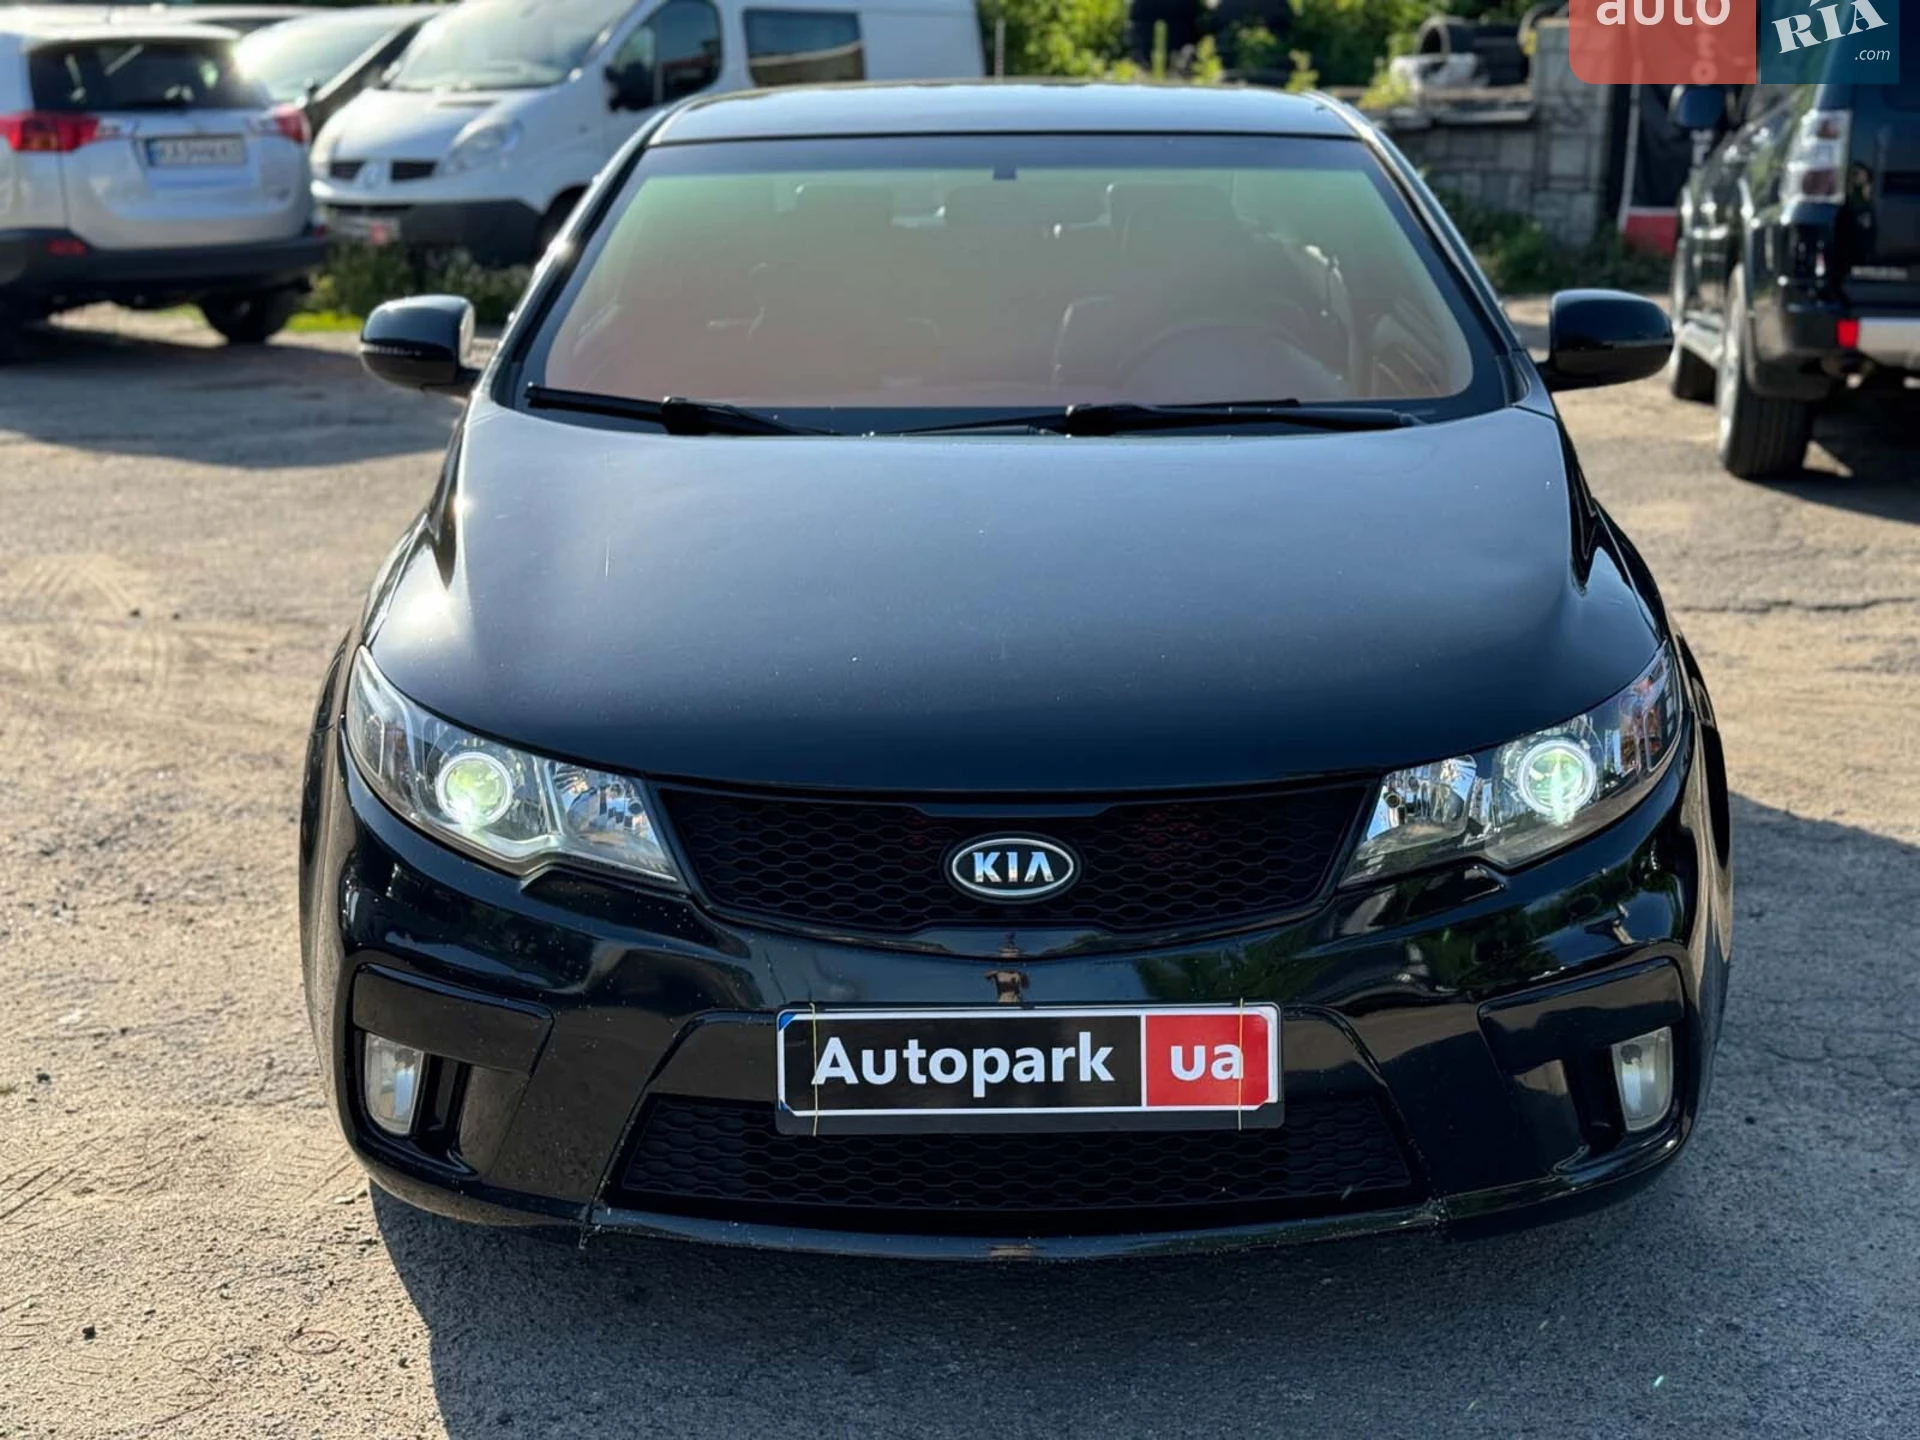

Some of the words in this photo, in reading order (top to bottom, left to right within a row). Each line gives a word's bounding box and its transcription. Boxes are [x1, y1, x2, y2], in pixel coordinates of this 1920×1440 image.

[972, 851, 1055, 883] KIA
[811, 1032, 1114, 1098] Autopark
[1171, 1043, 1244, 1080] ua
